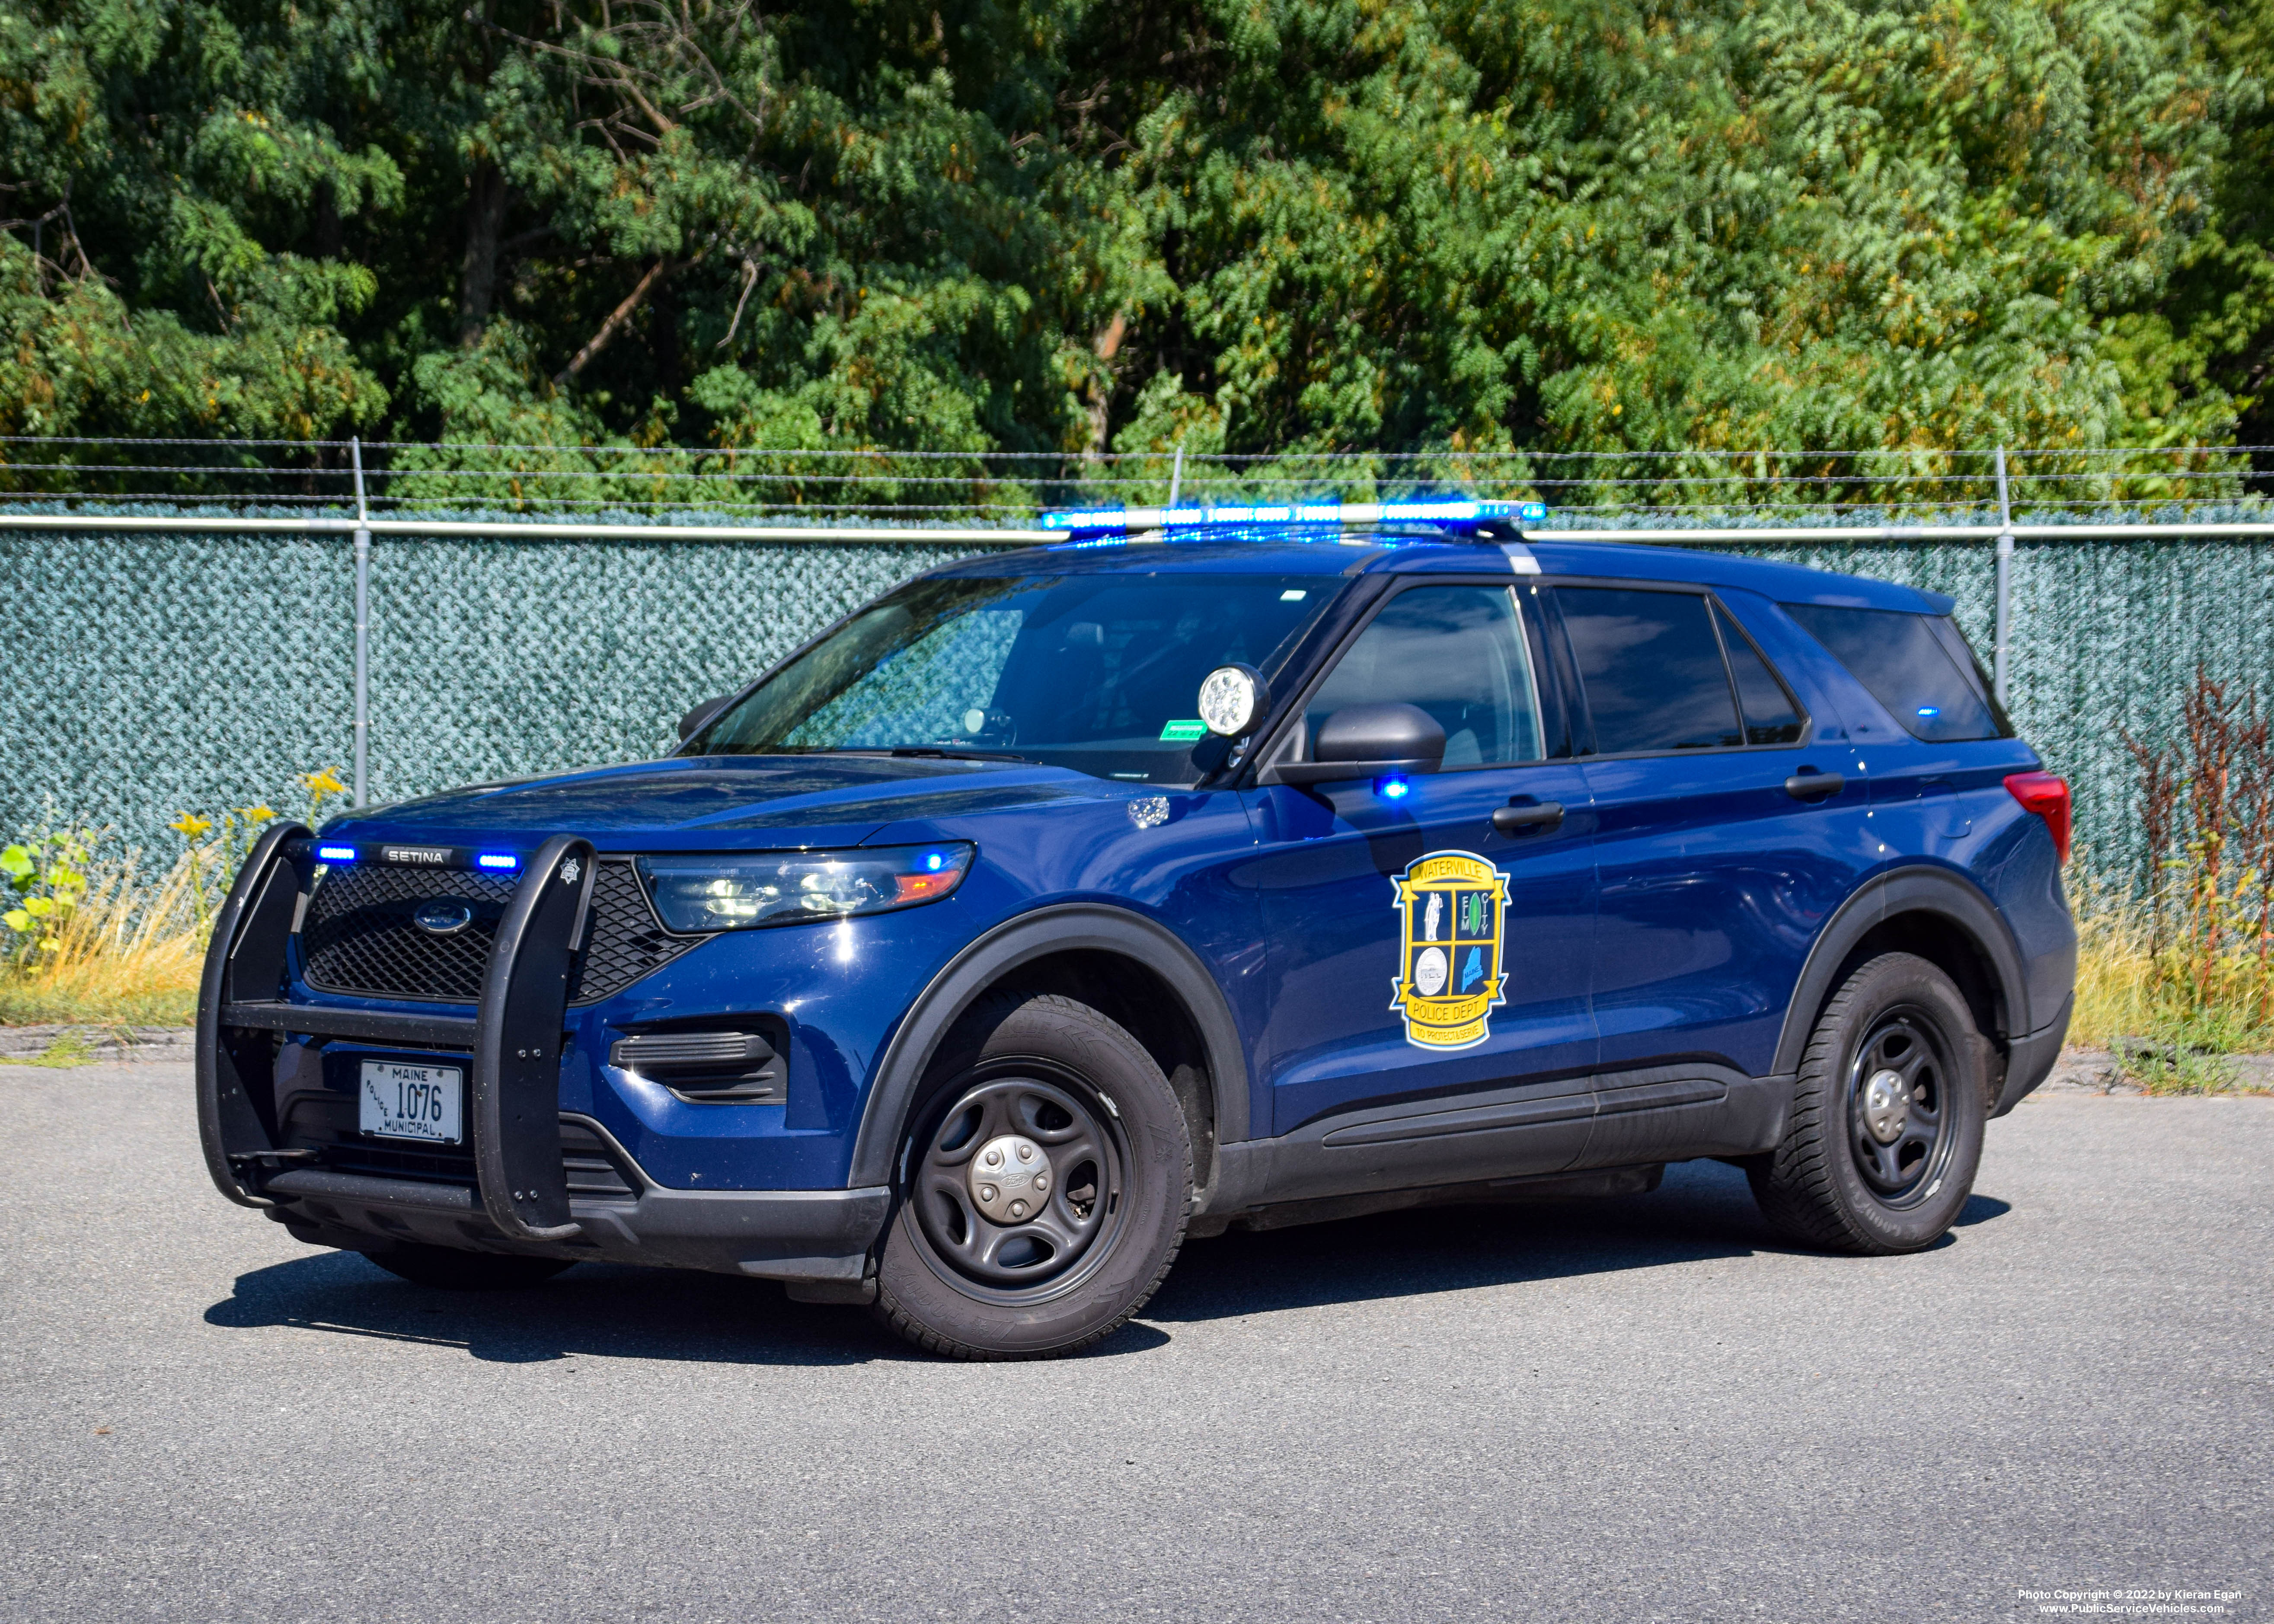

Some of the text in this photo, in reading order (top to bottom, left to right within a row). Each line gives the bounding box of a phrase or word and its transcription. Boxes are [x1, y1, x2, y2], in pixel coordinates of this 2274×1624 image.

[389, 851, 444, 863] SETINA
[1418, 861, 1482, 879] WATERVILLE
[1465, 966, 1479, 978] MAINE
[1414, 1001, 1481, 1021] POLICE DEPT.
[1416, 1027, 1425, 1038] TO
[393, 1069, 428, 1081] MAINE
[367, 1080, 388, 1117] POLICE
[397, 1082, 442, 1121] 1076
[385, 1120, 435, 1136] MUNICIPAL
